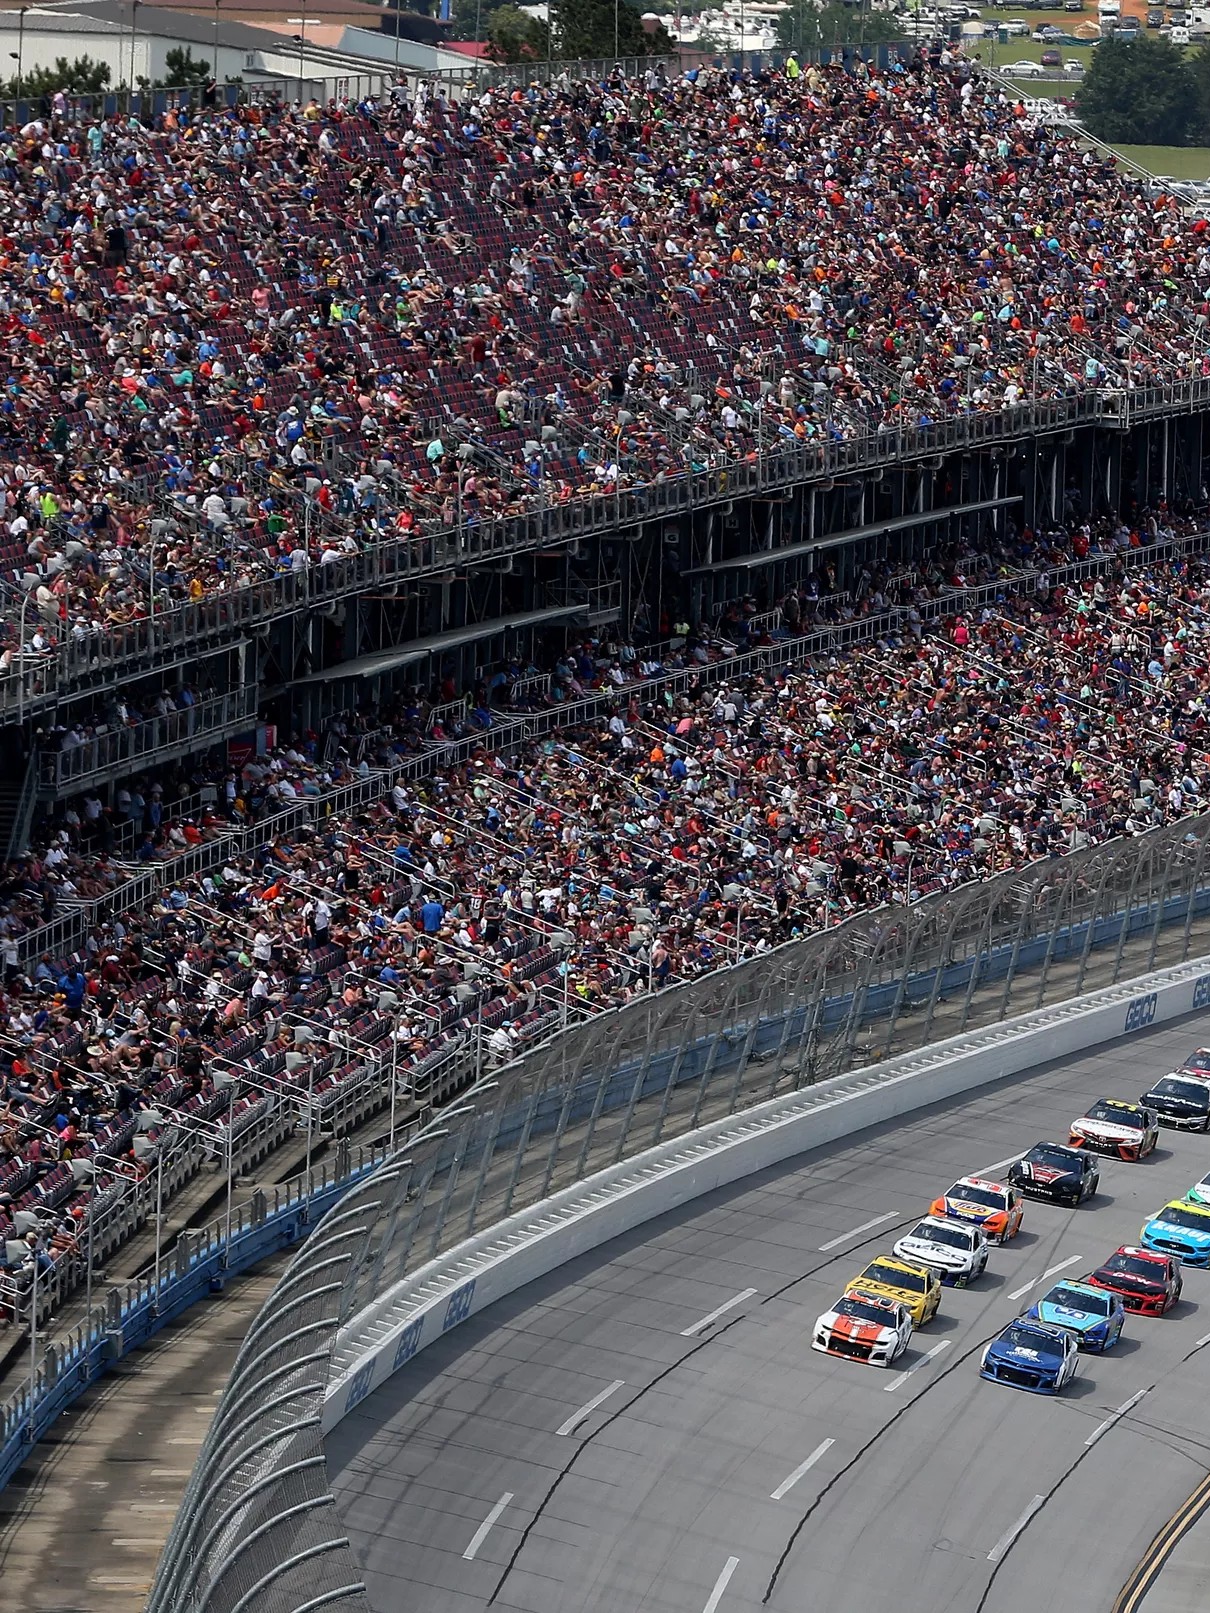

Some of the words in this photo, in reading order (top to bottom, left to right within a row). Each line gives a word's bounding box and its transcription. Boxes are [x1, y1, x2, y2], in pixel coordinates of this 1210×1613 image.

[1125, 993, 1157, 1031] GEICO
[1151, 1222, 1210, 1242] KNAUF
[853, 1279, 922, 1303] Hertz
